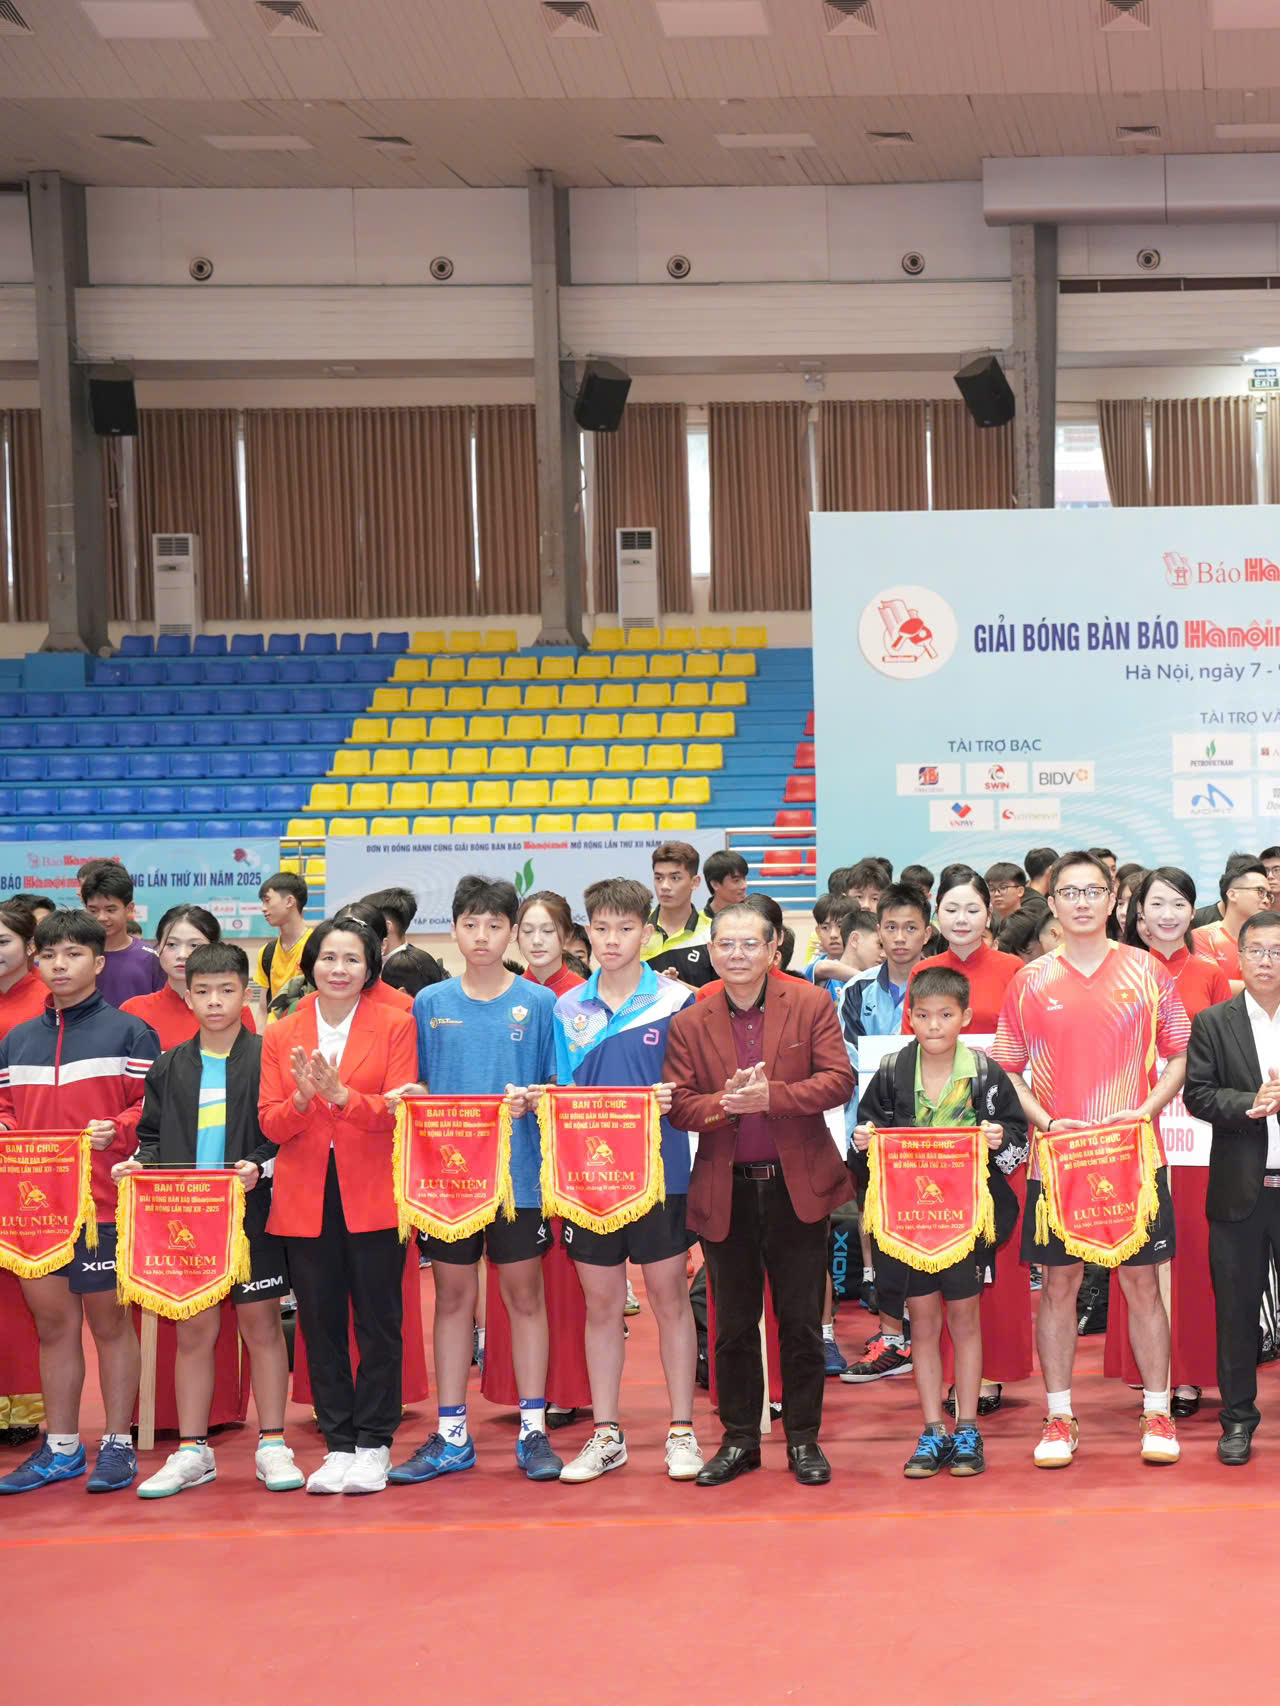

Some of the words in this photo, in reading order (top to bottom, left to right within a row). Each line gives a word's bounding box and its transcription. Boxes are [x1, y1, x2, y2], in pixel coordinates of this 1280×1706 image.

[1197, 561, 1241, 585] Báo
[974, 614, 1015, 653] GIẢI
[1023, 616, 1080, 653] BÓNG
[1087, 615, 1130, 651] BÀN
[1137, 614, 1179, 650] BÁO
[1125, 664, 1152, 681] Hà
[1157, 662, 1195, 683] Nội,
[1199, 662, 1245, 682] ngày
[1250, 662, 1262, 678] 7
[1200, 709, 1224, 725] TÀI
[1228, 711, 1258, 727] TRỢ
[947, 738, 972, 753] TÀI
[976, 739, 1007, 755] TRỢ
[1009, 738, 1042, 755] BẠC
[1190, 759, 1234, 767] PETROVIETNAM
[984, 782, 1010, 791] SWIN
[1039, 772, 1075, 786] BIDV
[193, 873, 207, 887] XII
[210, 869, 234, 886] NĂM
[237, 872, 262, 886] 2025
[571, 1100, 590, 1109] BAN
[604, 1099, 627, 1109] CHỨC
[426, 1109, 445, 1118] BAN
[459, 1107, 481, 1117] CHỨC
[6, 1143, 23, 1154] BAN
[37, 1142, 60, 1153] CHỨC
[1069, 1138, 1087, 1149] BAN
[1099, 1132, 1121, 1145] CHỨC
[1160, 1128, 1195, 1153] DRO
[420, 1179, 449, 1190] LƯU
[451, 1178, 487, 1190] NIỆM
[567, 1171, 596, 1182] LƯU
[598, 1170, 635, 1183] NIỆM
[154, 1184, 176, 1193] BAN
[187, 1182, 211, 1193] CHỨC
[897, 1210, 925, 1221] LƯU
[928, 1208, 964, 1222] NIỆM
[1073, 1208, 1101, 1222] LƯU
[1103, 1201, 1136, 1218] NIỆM
[2, 1215, 30, 1228] LƯU
[32, 1213, 70, 1229] NIỆM
[82, 1261, 115, 1272] XIO
[144, 1255, 177, 1267] LƯU
[180, 1254, 217, 1268] NIỆM
[832, 1231, 849, 1294] XIOM
[242, 1275, 284, 1294] XIOM
